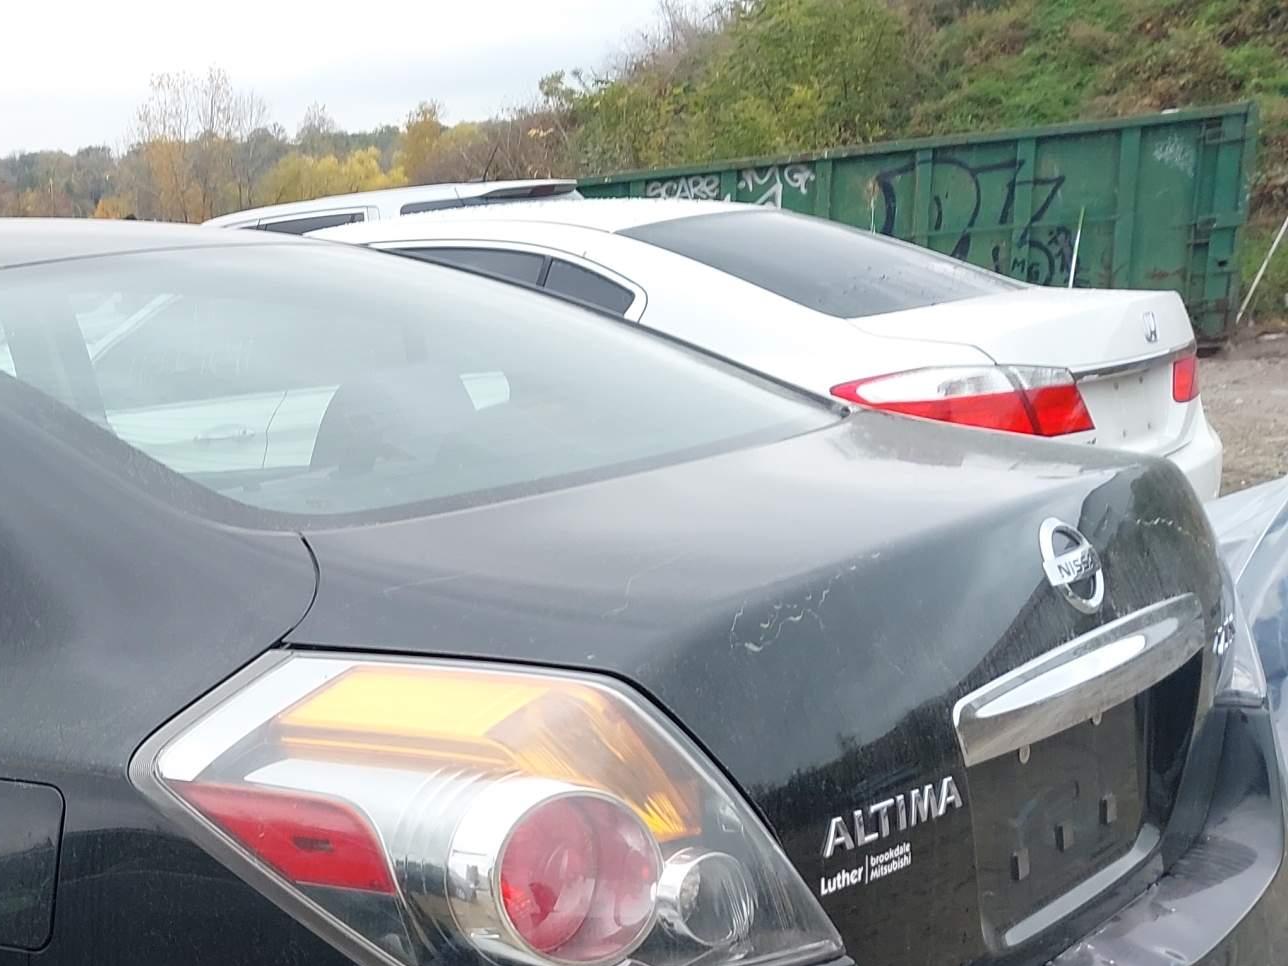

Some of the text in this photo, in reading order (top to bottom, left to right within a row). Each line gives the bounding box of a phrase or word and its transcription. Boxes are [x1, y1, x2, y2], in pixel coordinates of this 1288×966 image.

[822, 776, 962, 859] ALTIMA
[869, 853, 912, 881] Mitsubishi
[870, 842, 911, 868] brookdale
[820, 865, 864, 896] Luther
